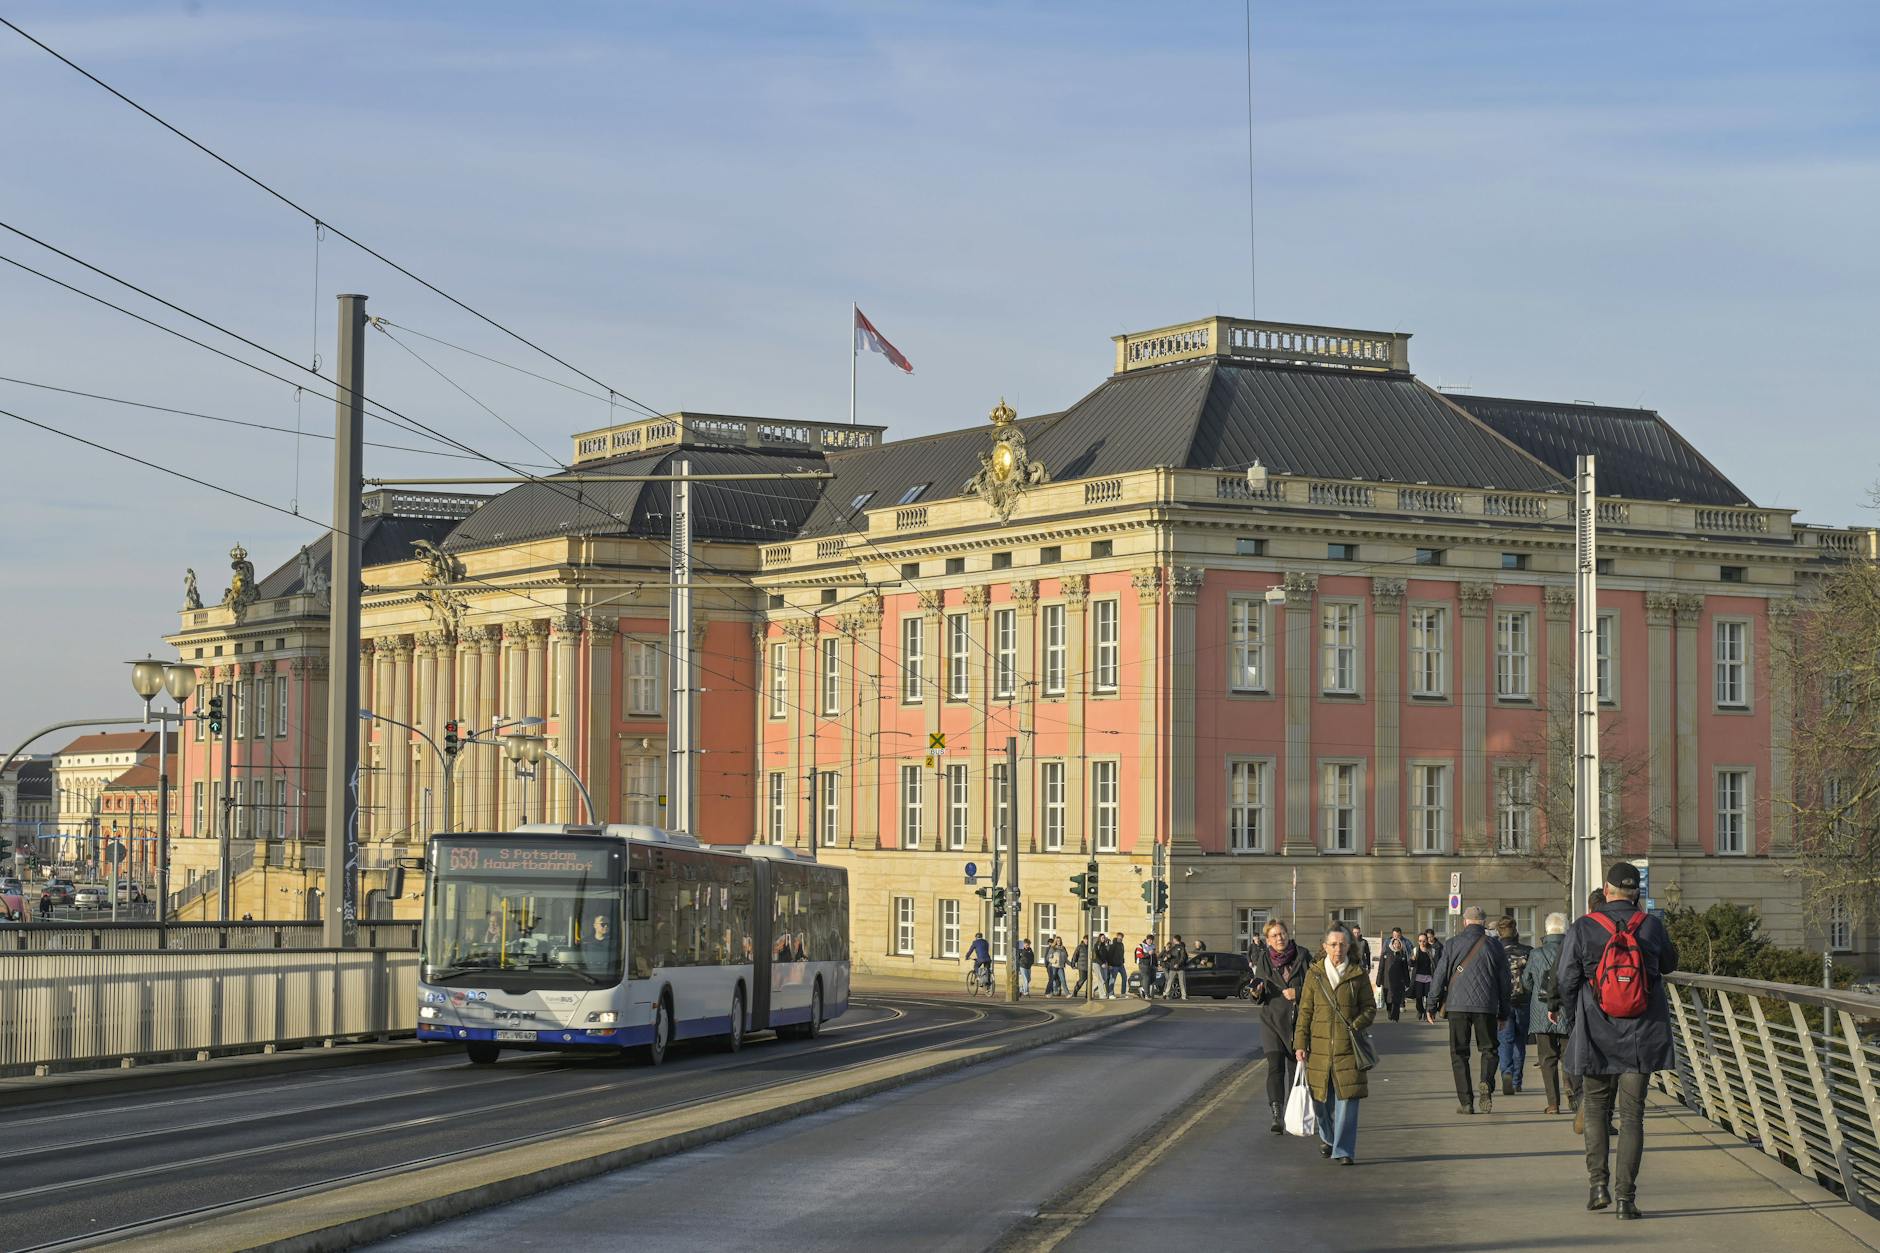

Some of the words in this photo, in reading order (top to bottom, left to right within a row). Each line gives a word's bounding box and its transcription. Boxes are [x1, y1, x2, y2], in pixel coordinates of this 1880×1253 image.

[927, 757, 933, 765] 2
[450, 848, 479, 870] 650
[500, 849, 509, 859] S
[513, 849, 577, 861] Potsdam
[495, 1010, 536, 1020] MAN
